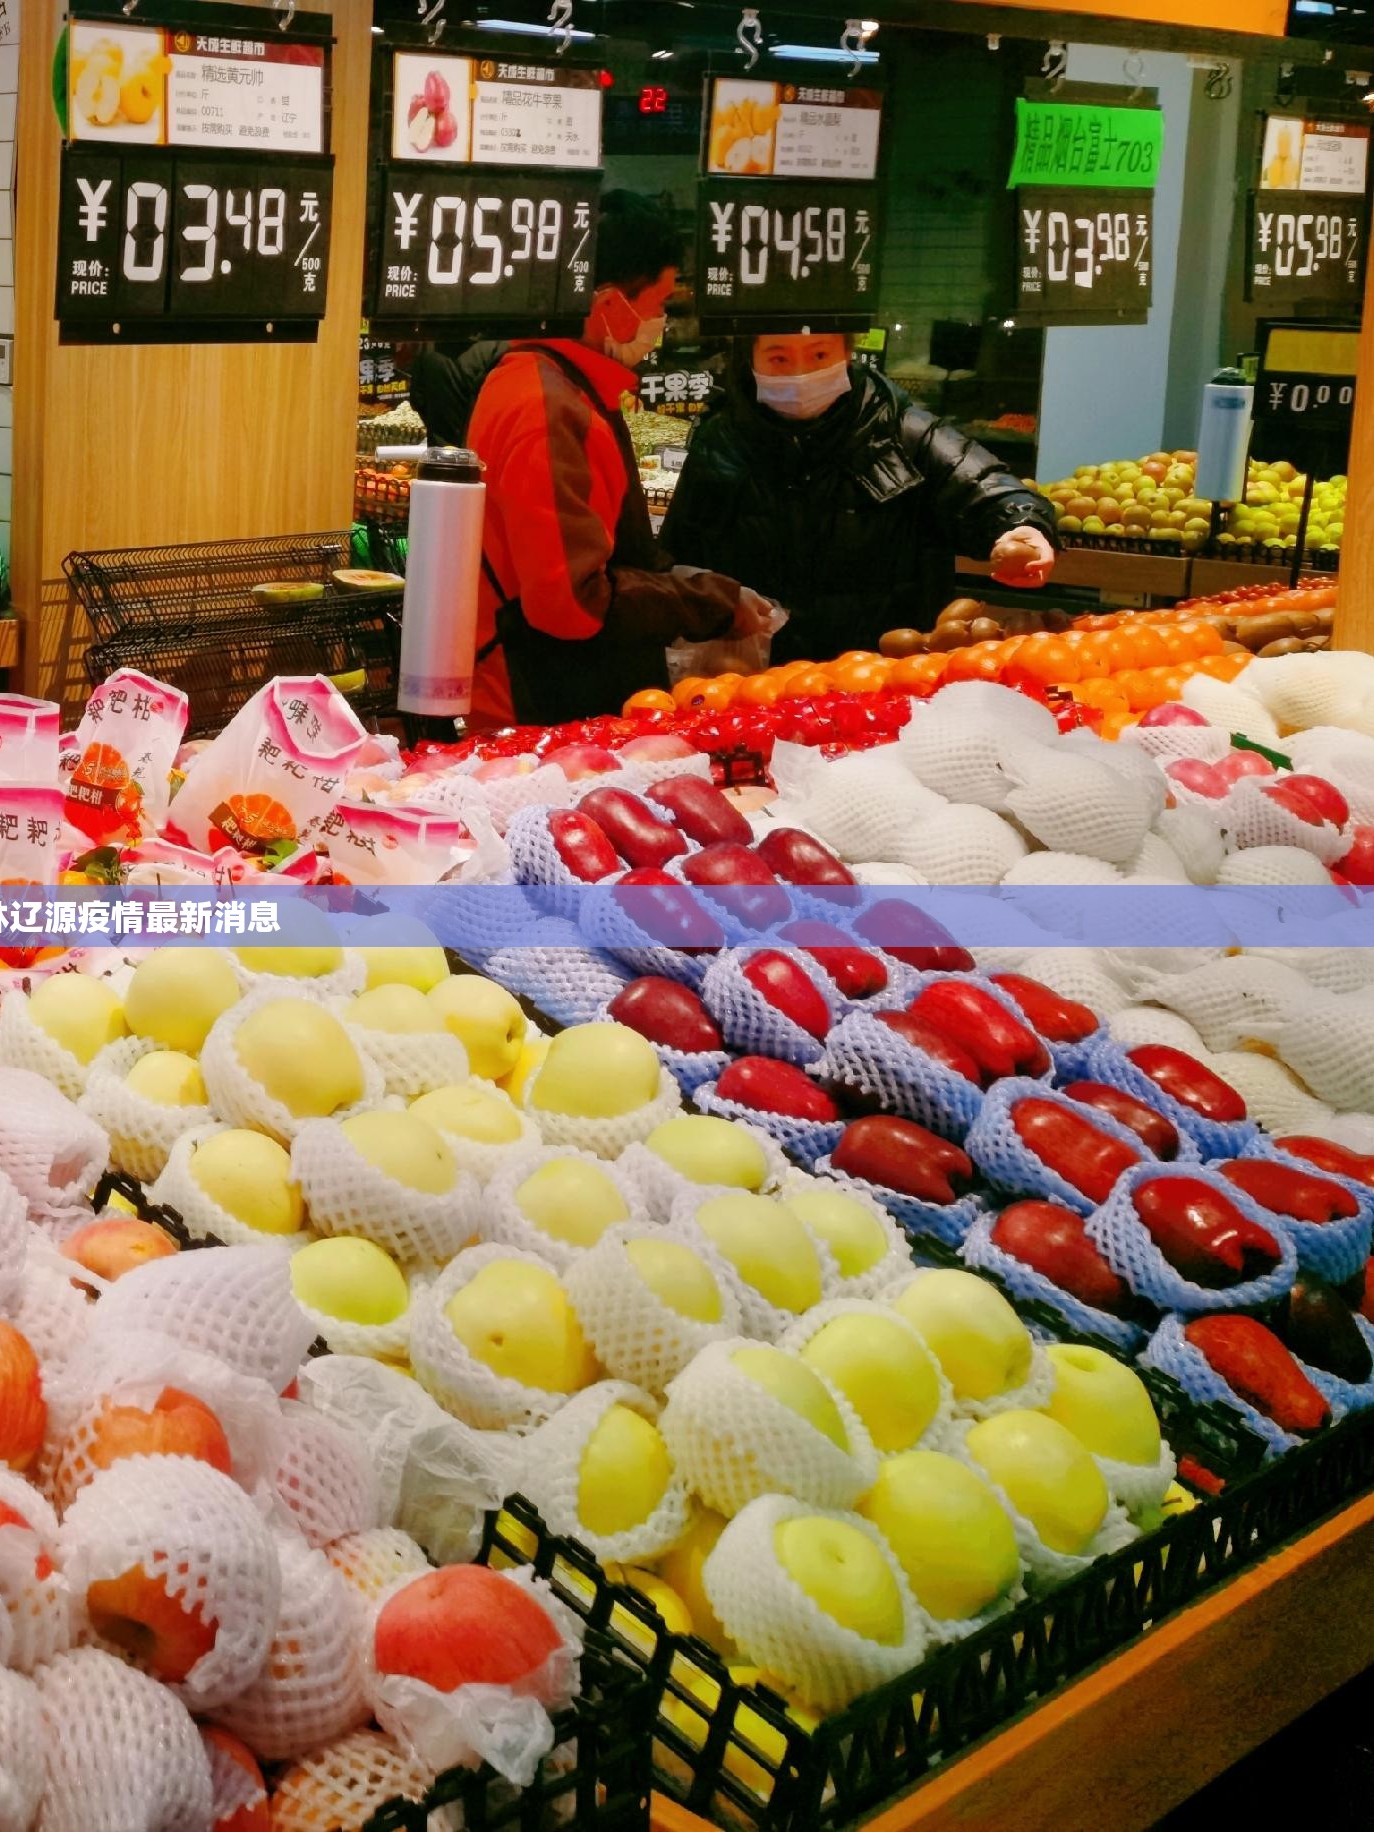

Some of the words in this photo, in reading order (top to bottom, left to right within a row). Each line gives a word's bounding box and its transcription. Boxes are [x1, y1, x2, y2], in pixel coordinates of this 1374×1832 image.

[71, 281, 108, 296] PRICE
[385, 284, 416, 298] PRICE
[707, 283, 732, 296] PRICE
[640, 372, 711, 404] 干果季
